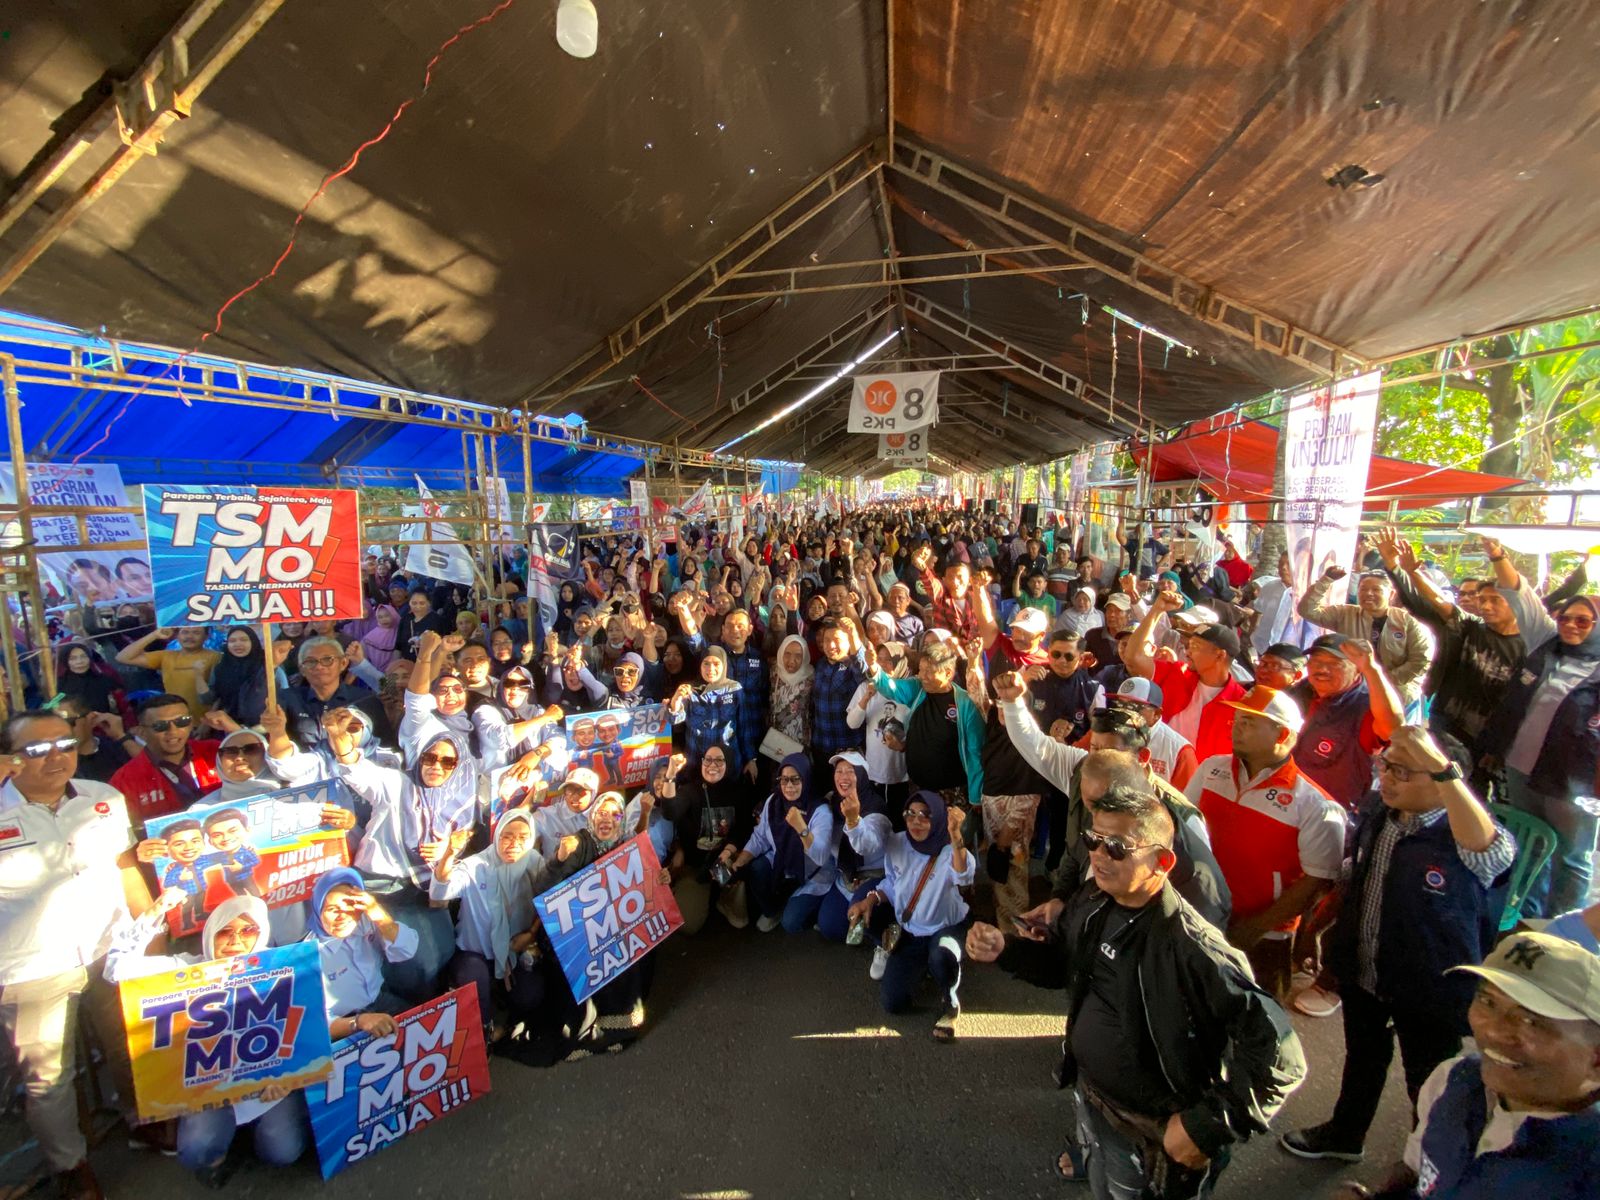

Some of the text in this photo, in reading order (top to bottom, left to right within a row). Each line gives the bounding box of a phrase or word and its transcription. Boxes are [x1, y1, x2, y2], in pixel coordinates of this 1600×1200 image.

[902, 387, 924, 421] 8
[1303, 411, 1353, 441] PRORAM
[908, 433, 920, 451] 8
[31, 492, 118, 507] NGGULAN
[162, 491, 333, 505] Parepare Terbaik, Sejahtera, Maju
[160, 501, 333, 548] TSM
[204, 582, 250, 591] TASMING
[258, 582, 313, 590] HERMANTO
[187, 592, 293, 622] SAJA
[1265, 788, 1278, 801] 8
[277, 843, 325, 868] UNTUK
[546, 847, 645, 935] TSM
[586, 932, 647, 987] SAJA
[142, 966, 293, 1005] Parepare Terbaik, Sejahtera, Maju
[142, 975, 294, 1049] TSM
[437, 996, 458, 1010] Maju
[326, 1003, 458, 1105] TSM
[185, 1072, 225, 1087] TASMING
[231, 1058, 281, 1075] HERMANTO
[358, 1106, 397, 1130] TASMING
[403, 1079, 449, 1107] HERMANTO
[346, 1101, 435, 1163] SAJA
